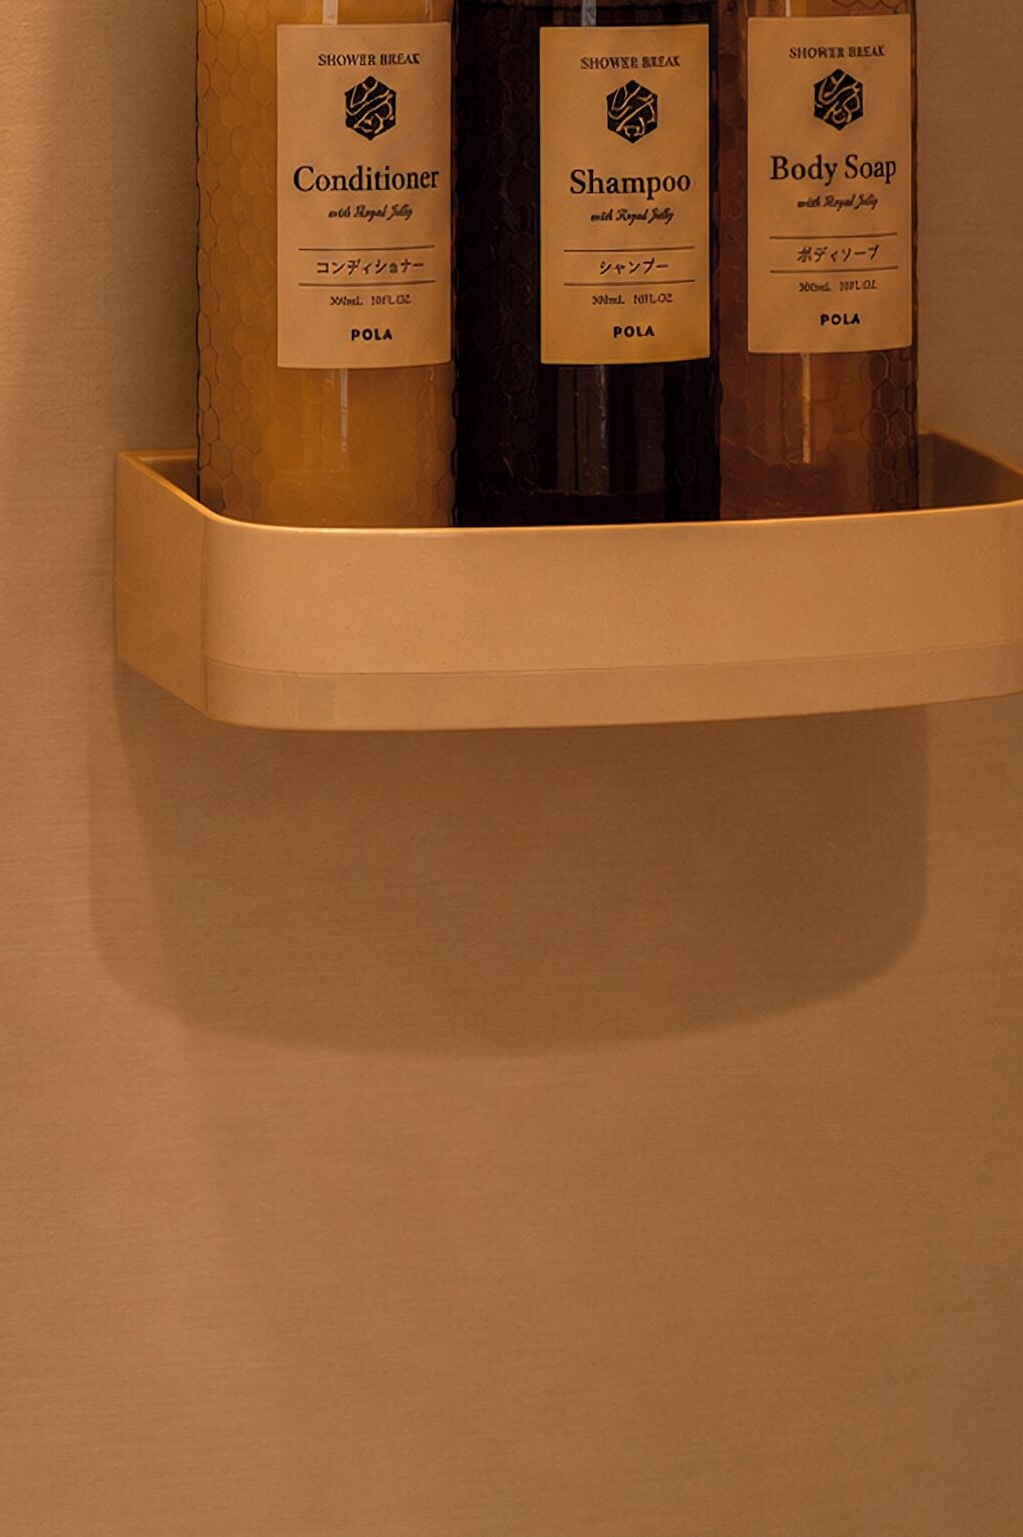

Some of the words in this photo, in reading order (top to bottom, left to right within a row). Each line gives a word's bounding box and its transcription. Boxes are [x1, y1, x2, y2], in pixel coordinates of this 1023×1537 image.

[318, 53, 376, 66] SHOWER
[380, 53, 420, 64] BREAK
[789, 47, 844, 59] SHOWER
[848, 45, 885, 58] BREAK
[580, 57, 638, 69] SHOWER
[642, 56, 681, 68] BREAK
[770, 154, 838, 186] Body
[844, 154, 897, 184] Soap
[293, 165, 439, 192] Conditioner
[570, 169, 691, 200] Shampoo
[796, 244, 880, 263] ボディソープ
[317, 258, 424, 276] コンディショナー
[600, 258, 669, 275] シャンプー
[820, 313, 861, 326] POLA
[351, 329, 393, 341] POLA
[613, 326, 655, 338] POLA
